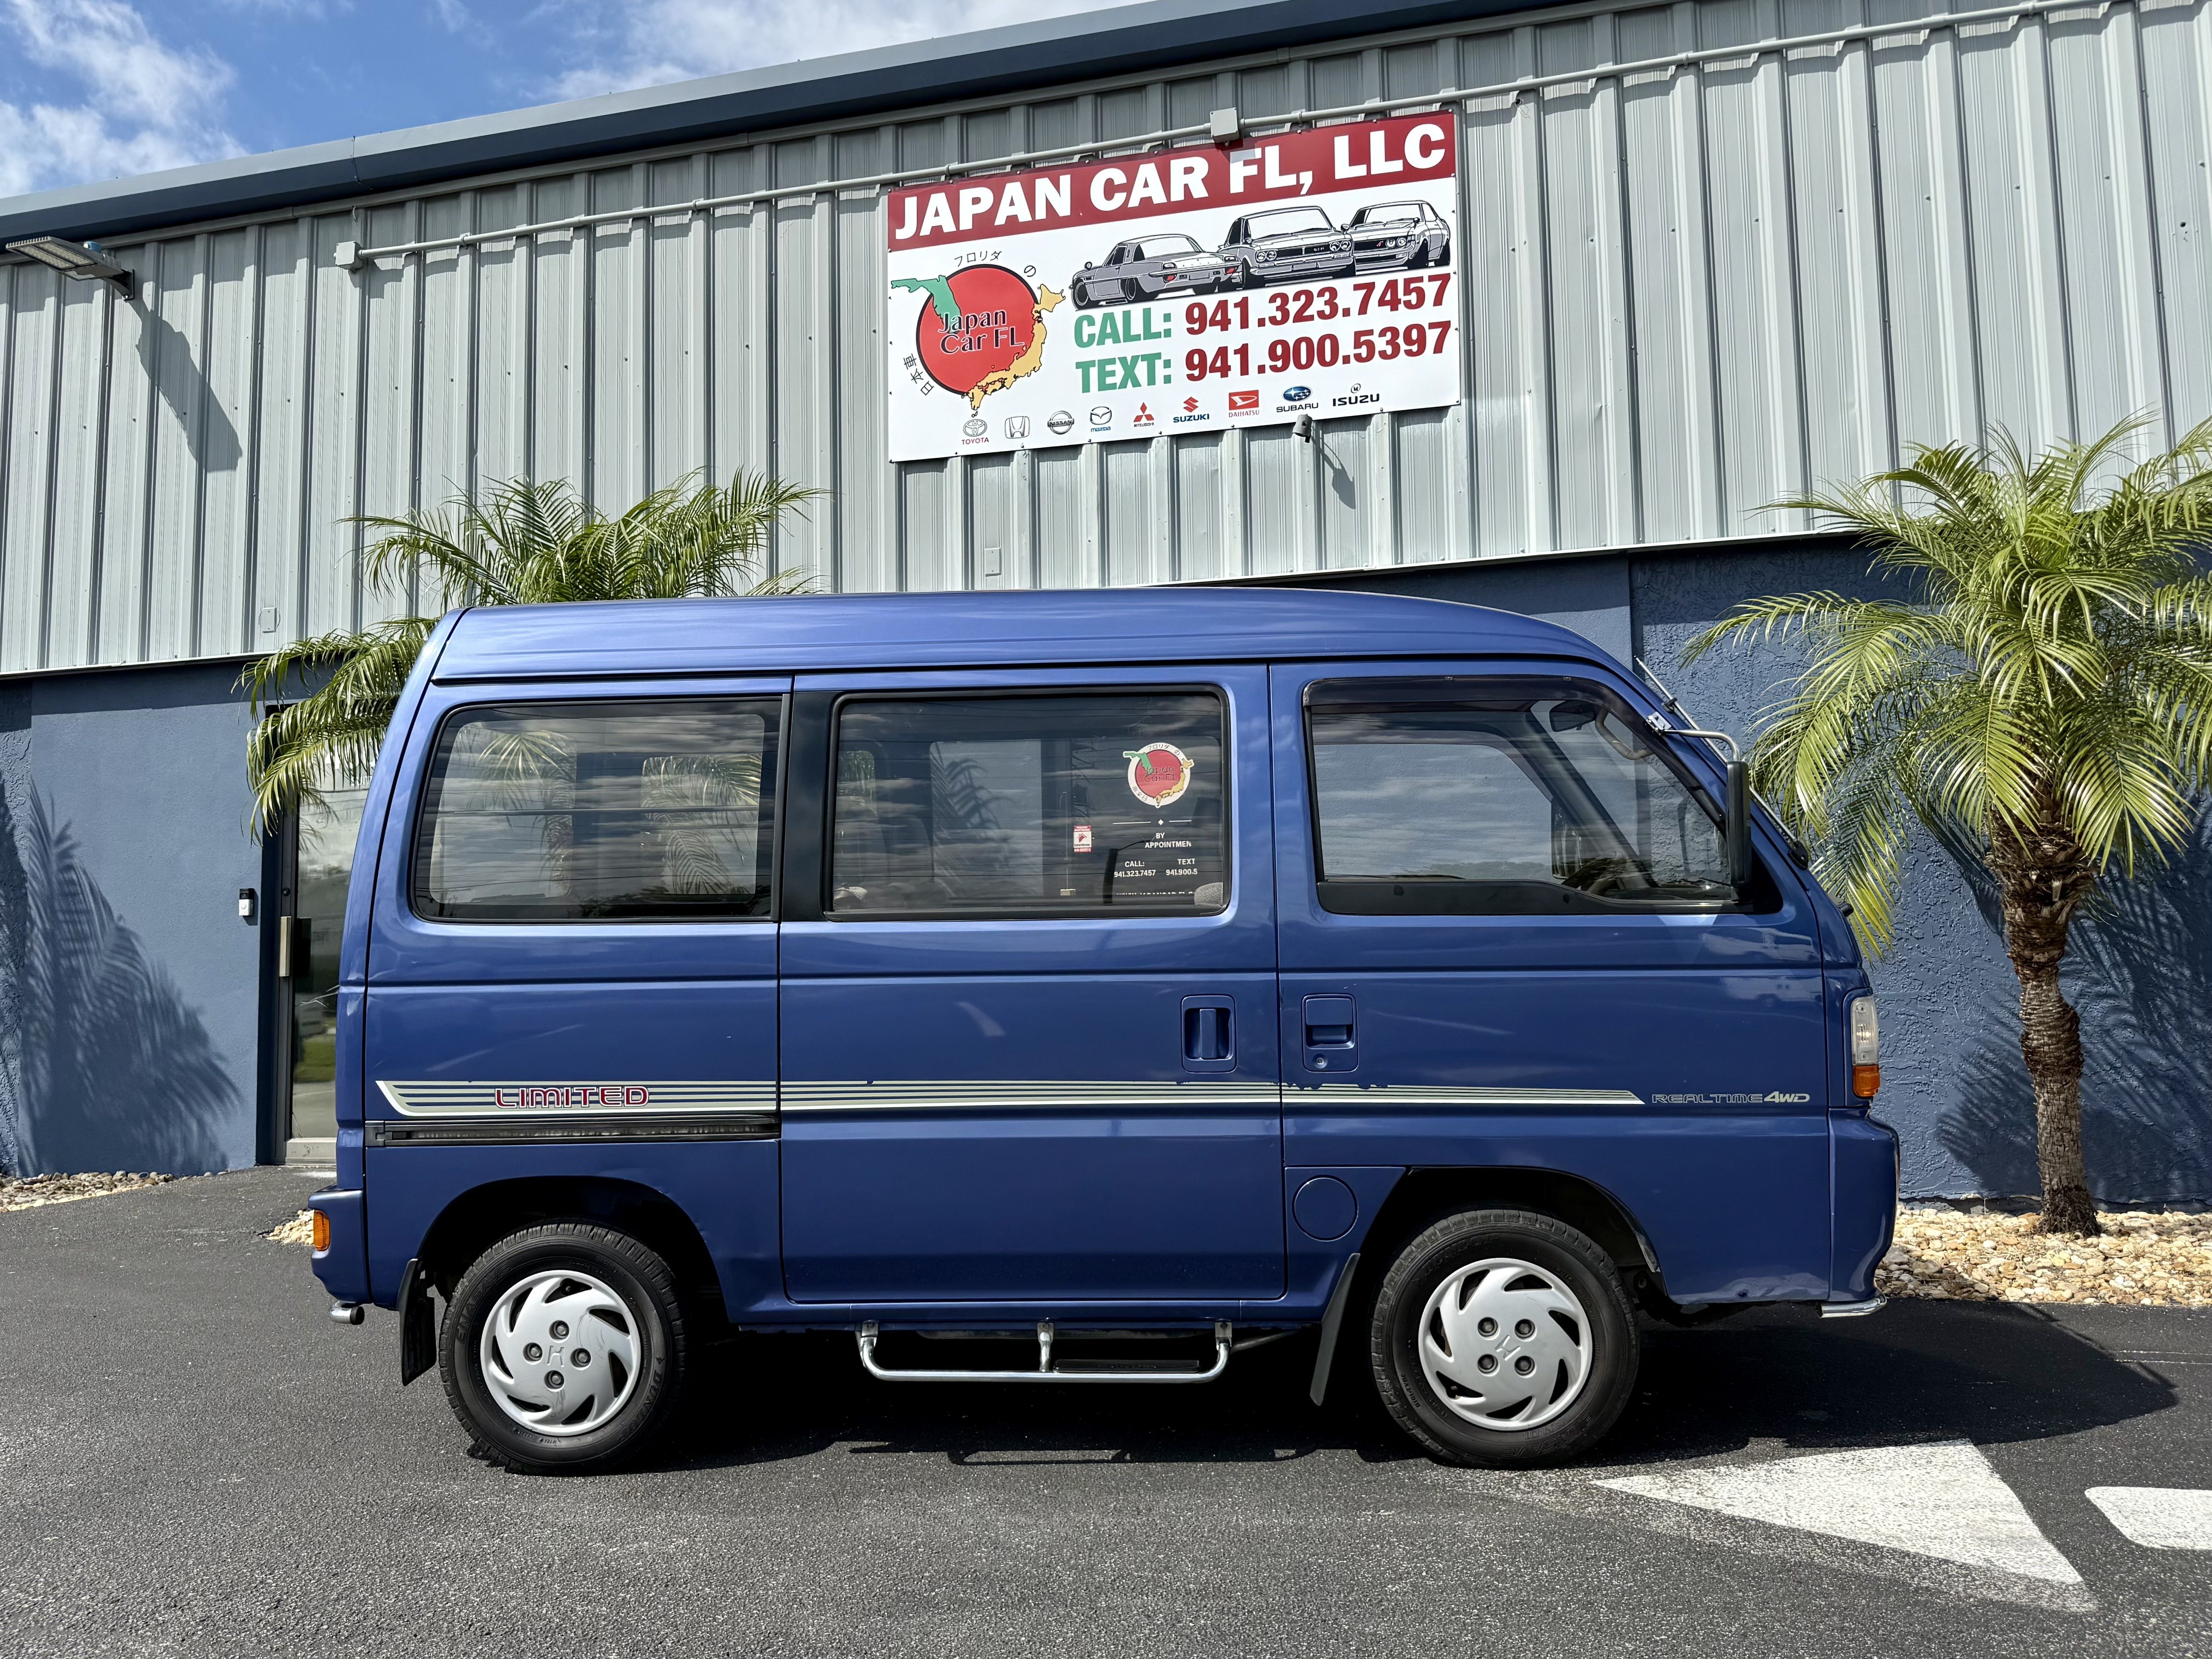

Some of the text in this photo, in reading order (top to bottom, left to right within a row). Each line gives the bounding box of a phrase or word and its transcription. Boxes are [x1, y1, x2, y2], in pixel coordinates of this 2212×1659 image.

[896, 123, 1445, 240] JAPAN CAR FL, LLC
[954, 250, 1002, 267] フロリダ
[1074, 273, 1451, 348] CALL: 941.323.7457
[938, 309, 1007, 335] Japan
[940, 326, 1025, 354] Car FL
[1075, 320, 1451, 394] TEXT: 941.900.5397
[1276, 402, 1319, 413] SUBARU
[1332, 393, 1380, 406] ISUZU
[1173, 413, 1210, 423] SUZUKI
[1228, 409, 1260, 418] DAIHATSU
[961, 437, 990, 445] TOYOTA
[1114, 870, 1156, 878] 941.323.7457
[495, 1086, 650, 1108] LIMITED
